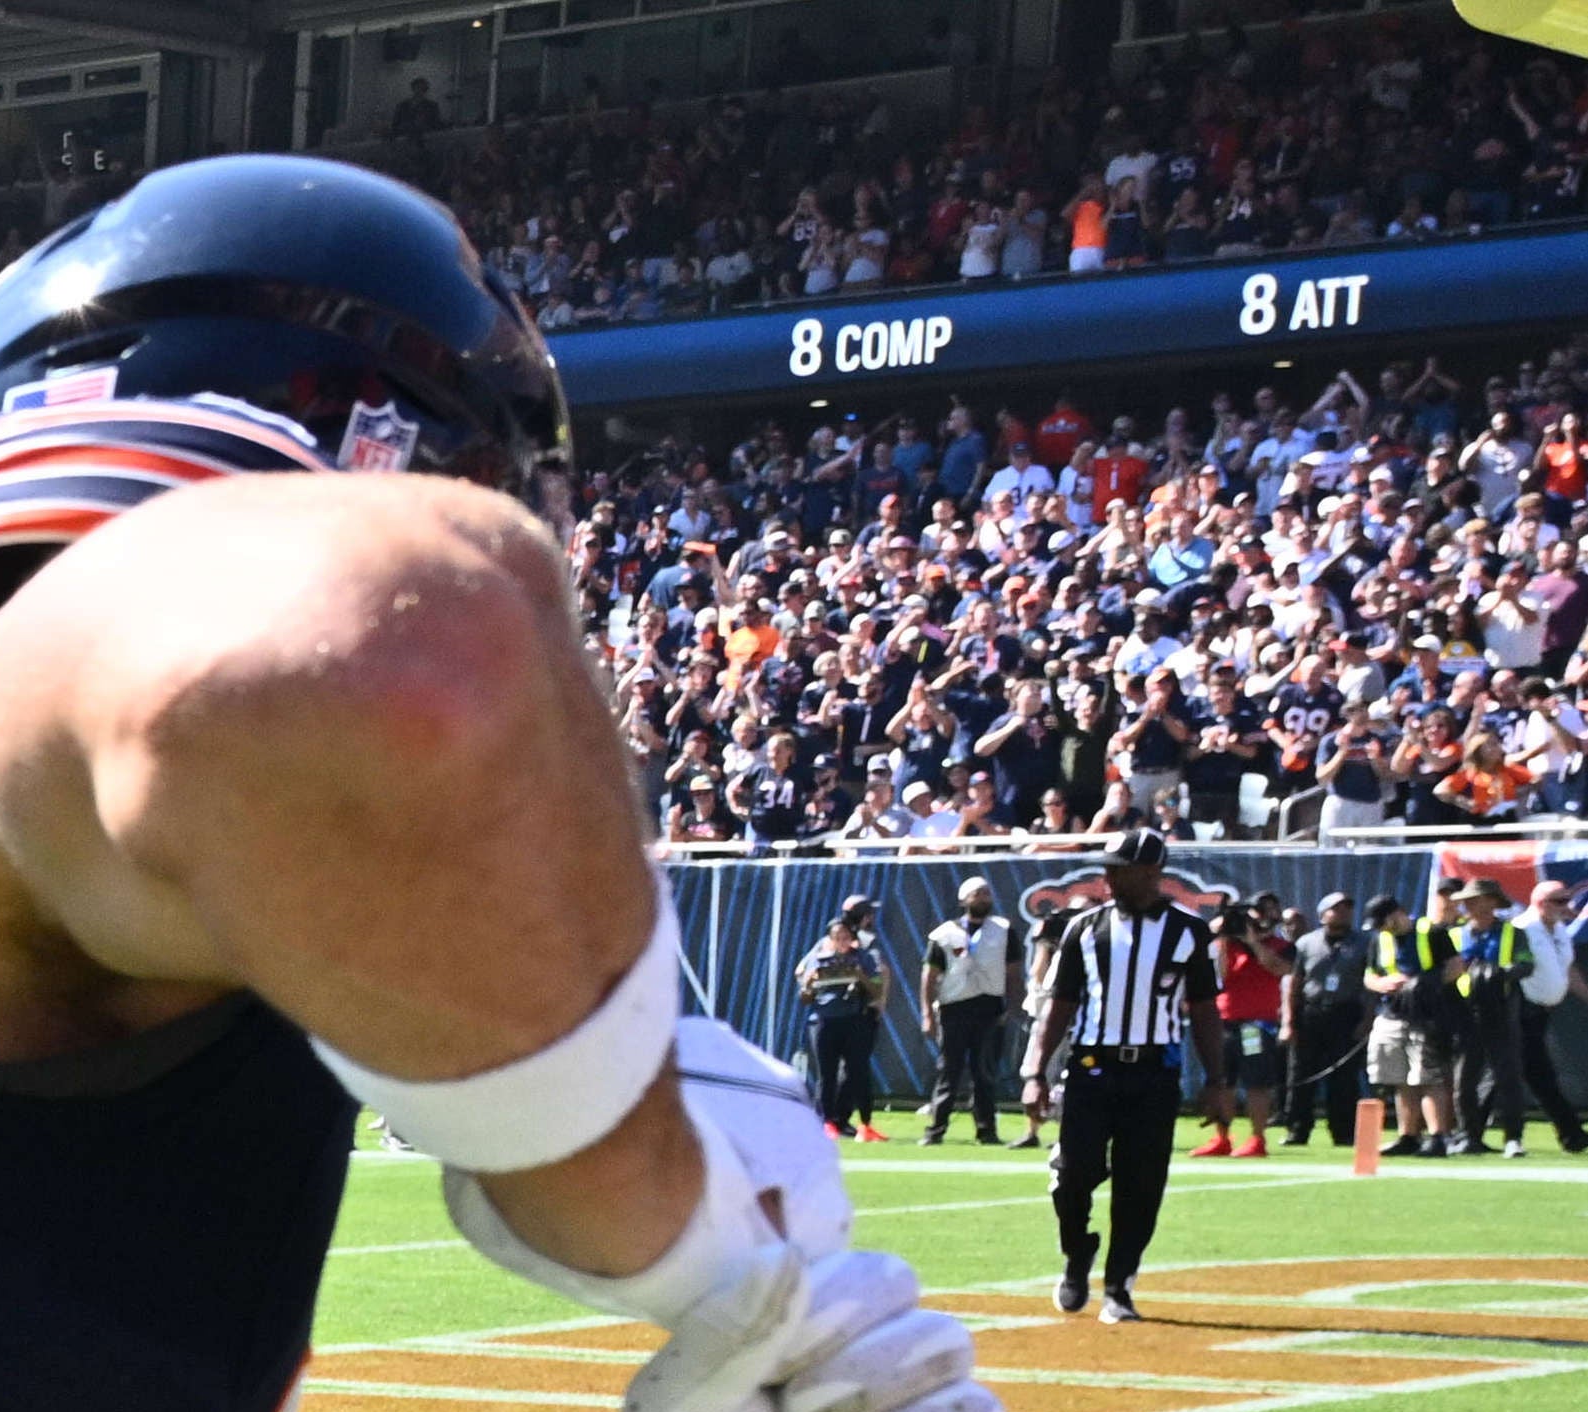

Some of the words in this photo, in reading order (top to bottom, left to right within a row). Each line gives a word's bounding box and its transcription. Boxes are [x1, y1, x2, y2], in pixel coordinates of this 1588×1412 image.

[1238, 274, 1277, 335] 8
[1288, 275, 1370, 331] ATT
[788, 318, 823, 376] 8
[835, 316, 952, 372] COMP
[1285, 706, 1331, 736] 99
[763, 779, 796, 809] 34
